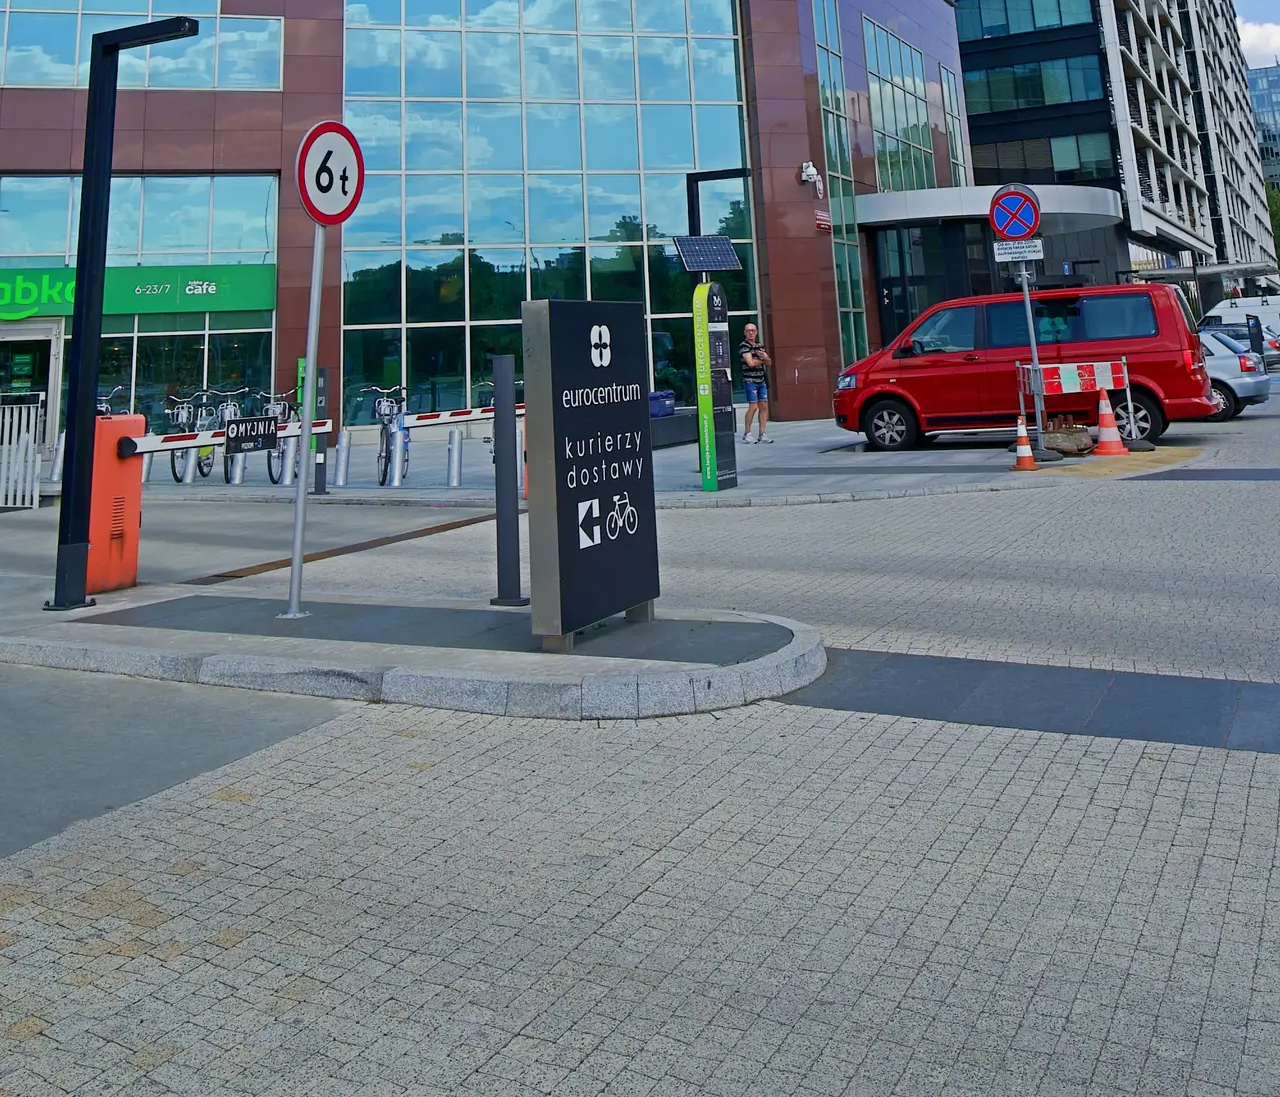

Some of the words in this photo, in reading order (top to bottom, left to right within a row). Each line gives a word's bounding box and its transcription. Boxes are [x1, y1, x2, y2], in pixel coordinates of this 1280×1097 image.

[134, 284, 171, 295] 6-23/7
[695, 300, 706, 379] EUROCENTRUM
[562, 383, 640, 407] eurocentrum
[238, 420, 276, 437] MYJNIA
[565, 431, 642, 459] kurierzy
[567, 457, 643, 489] dostawy
